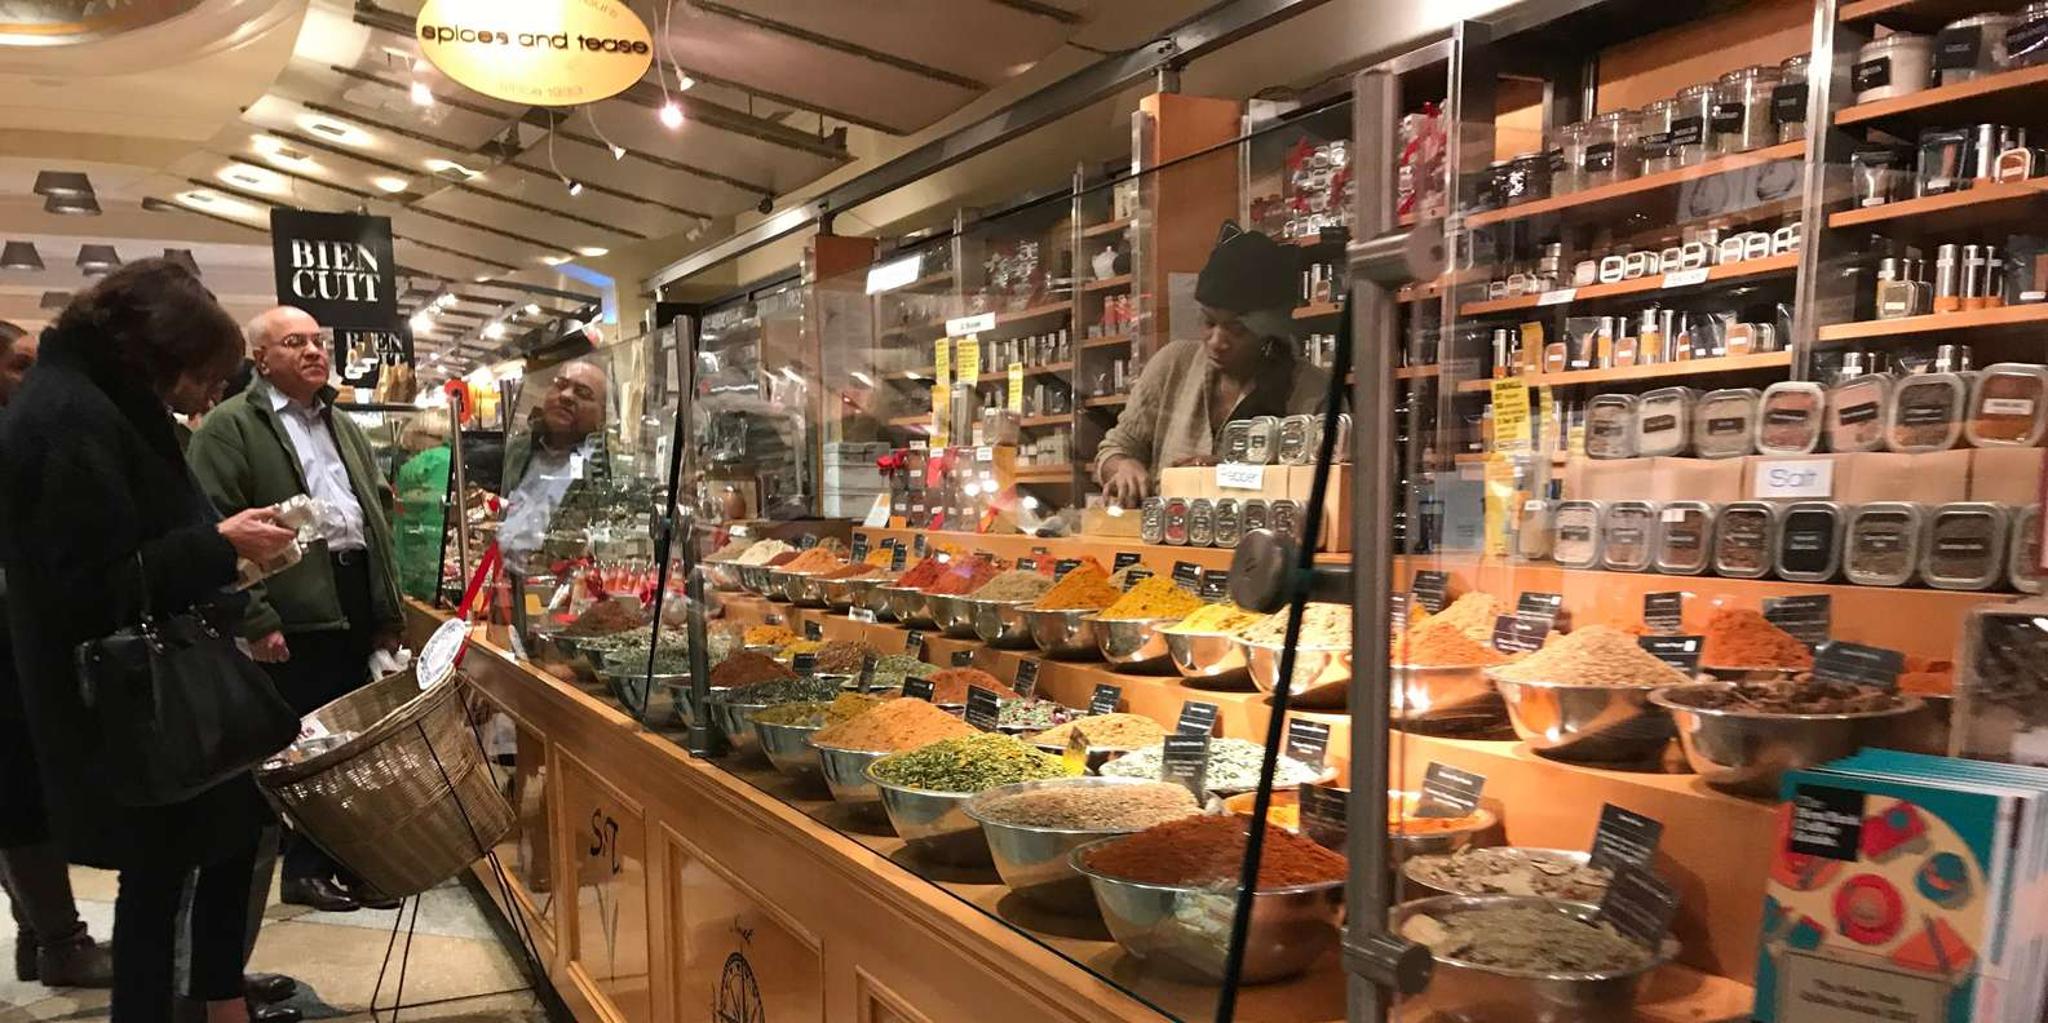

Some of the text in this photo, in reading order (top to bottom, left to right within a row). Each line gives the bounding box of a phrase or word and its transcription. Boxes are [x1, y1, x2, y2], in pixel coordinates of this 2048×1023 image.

[421, 25, 650, 54] spices and tease
[290, 239, 379, 272] BIEN
[291, 269, 381, 302] CUIT
[1769, 466, 1818, 488] Salt
